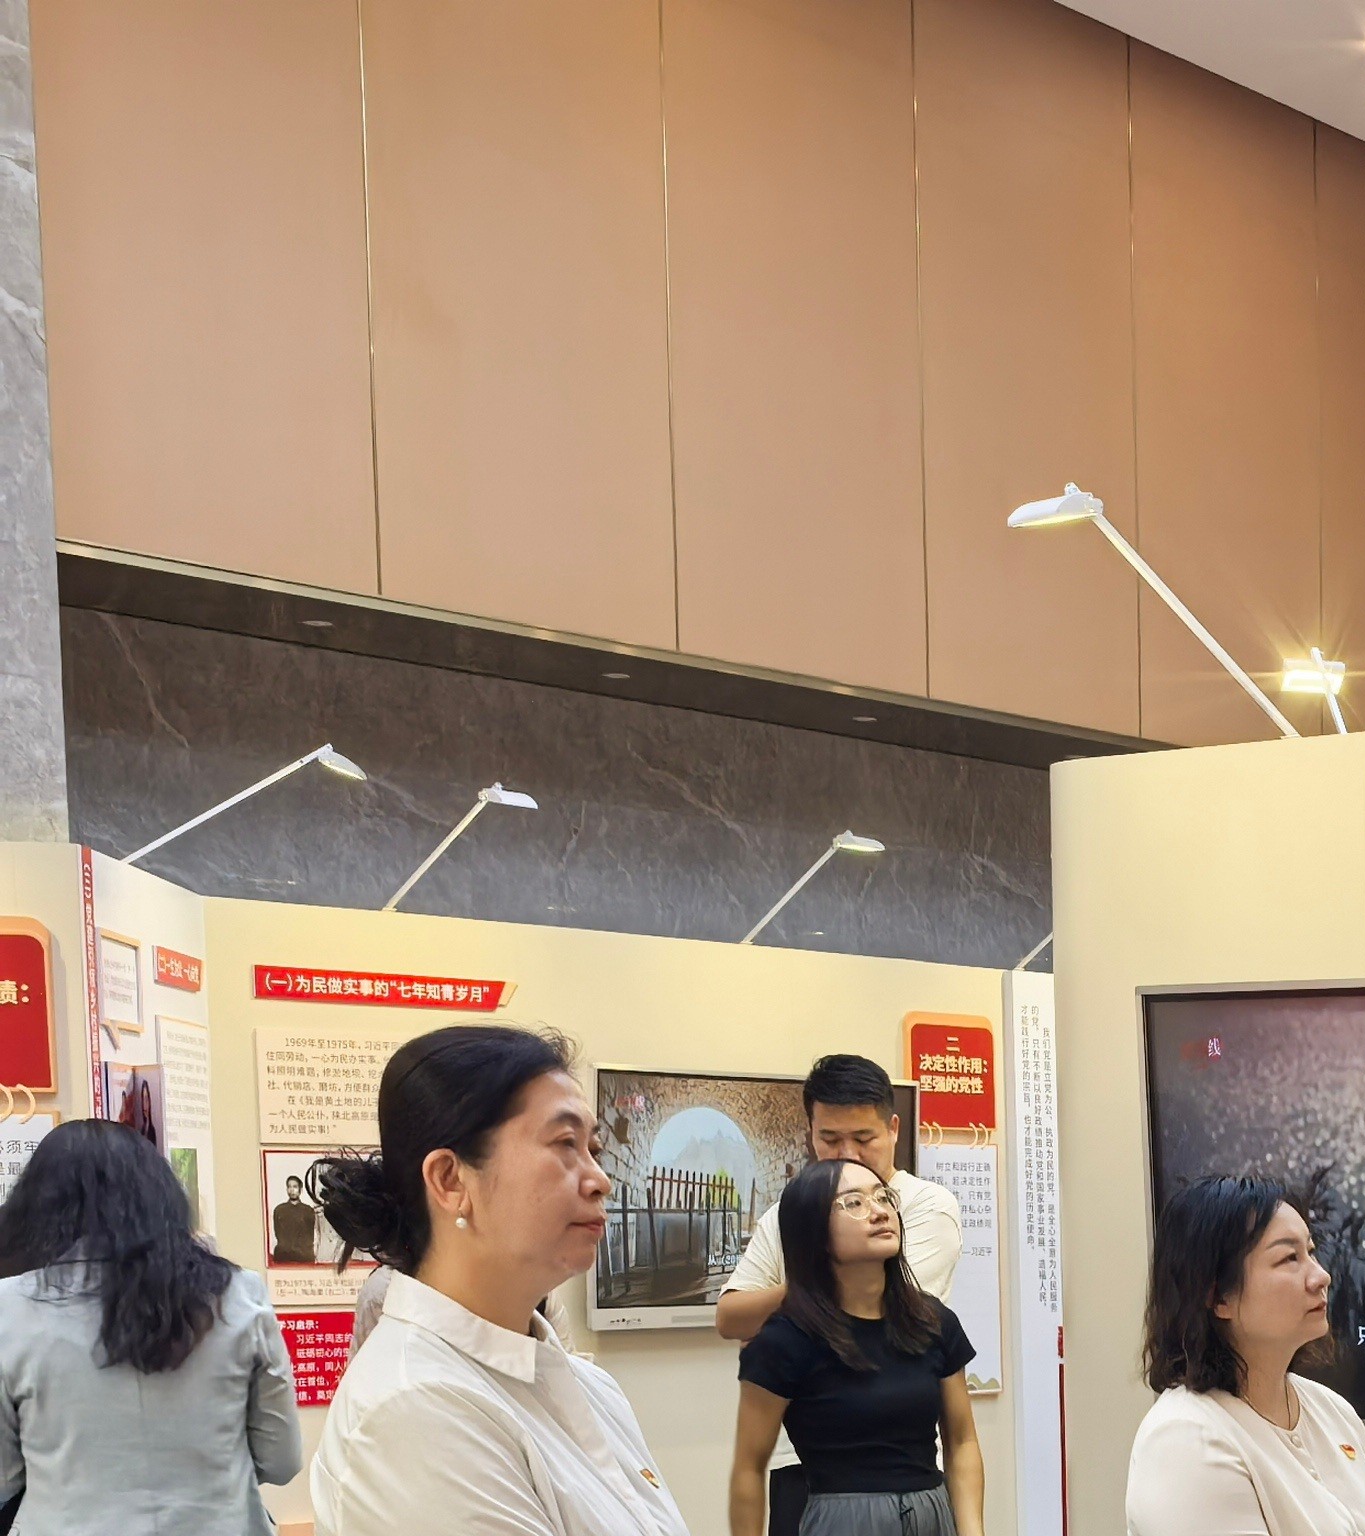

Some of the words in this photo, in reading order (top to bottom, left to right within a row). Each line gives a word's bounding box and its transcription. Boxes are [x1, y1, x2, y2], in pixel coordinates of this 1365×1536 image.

[945, 1036, 961, 1053] 二
[919, 1074, 985, 1095] 坚强的党性
